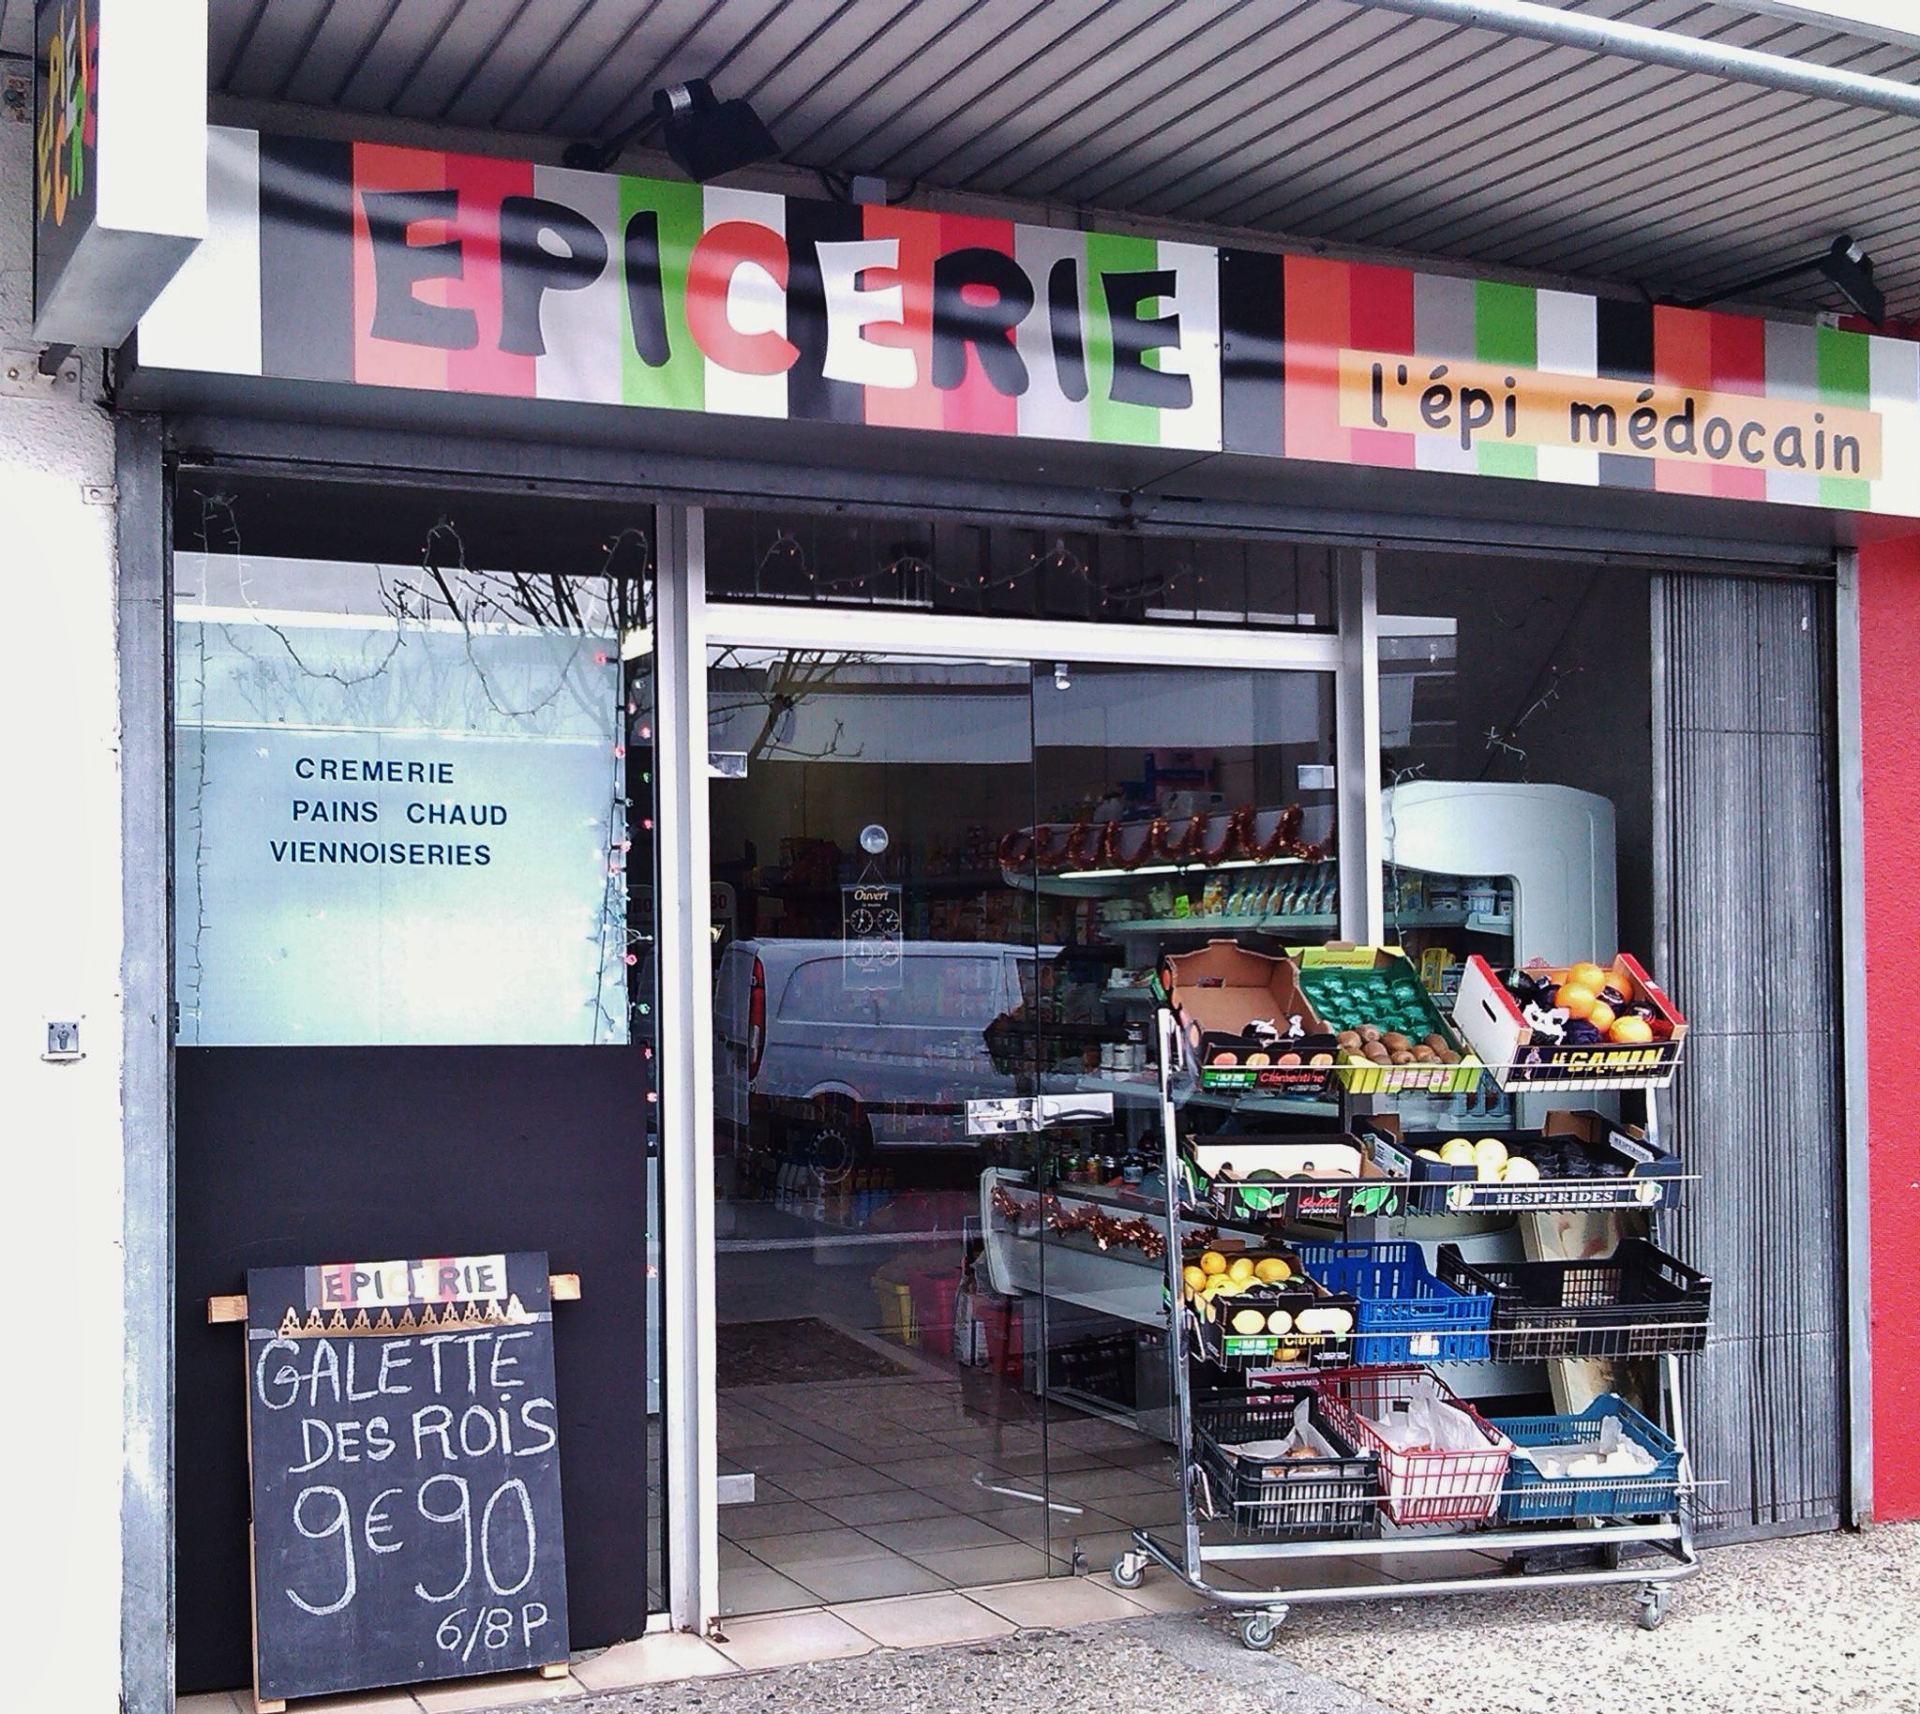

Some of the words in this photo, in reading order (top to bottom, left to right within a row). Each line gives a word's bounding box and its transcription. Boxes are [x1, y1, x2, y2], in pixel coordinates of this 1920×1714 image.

[360, 188, 1193, 410] EPICERIE
[1372, 362, 1516, 449] l'épi
[1570, 389, 1860, 473] médocain
[295, 758, 454, 783] CREMERIE
[292, 800, 378, 822] PAINS
[406, 803, 507, 825] CHAUD
[270, 841, 491, 865] VIENNOISERIES
[854, 889, 888, 901] Ouvert
[1495, 1191, 1614, 1204] HESPERIDES
[324, 1261, 497, 1303] EPICERIE
[257, 1331, 533, 1410] GALETTE
[288, 1416, 396, 1474] DES
